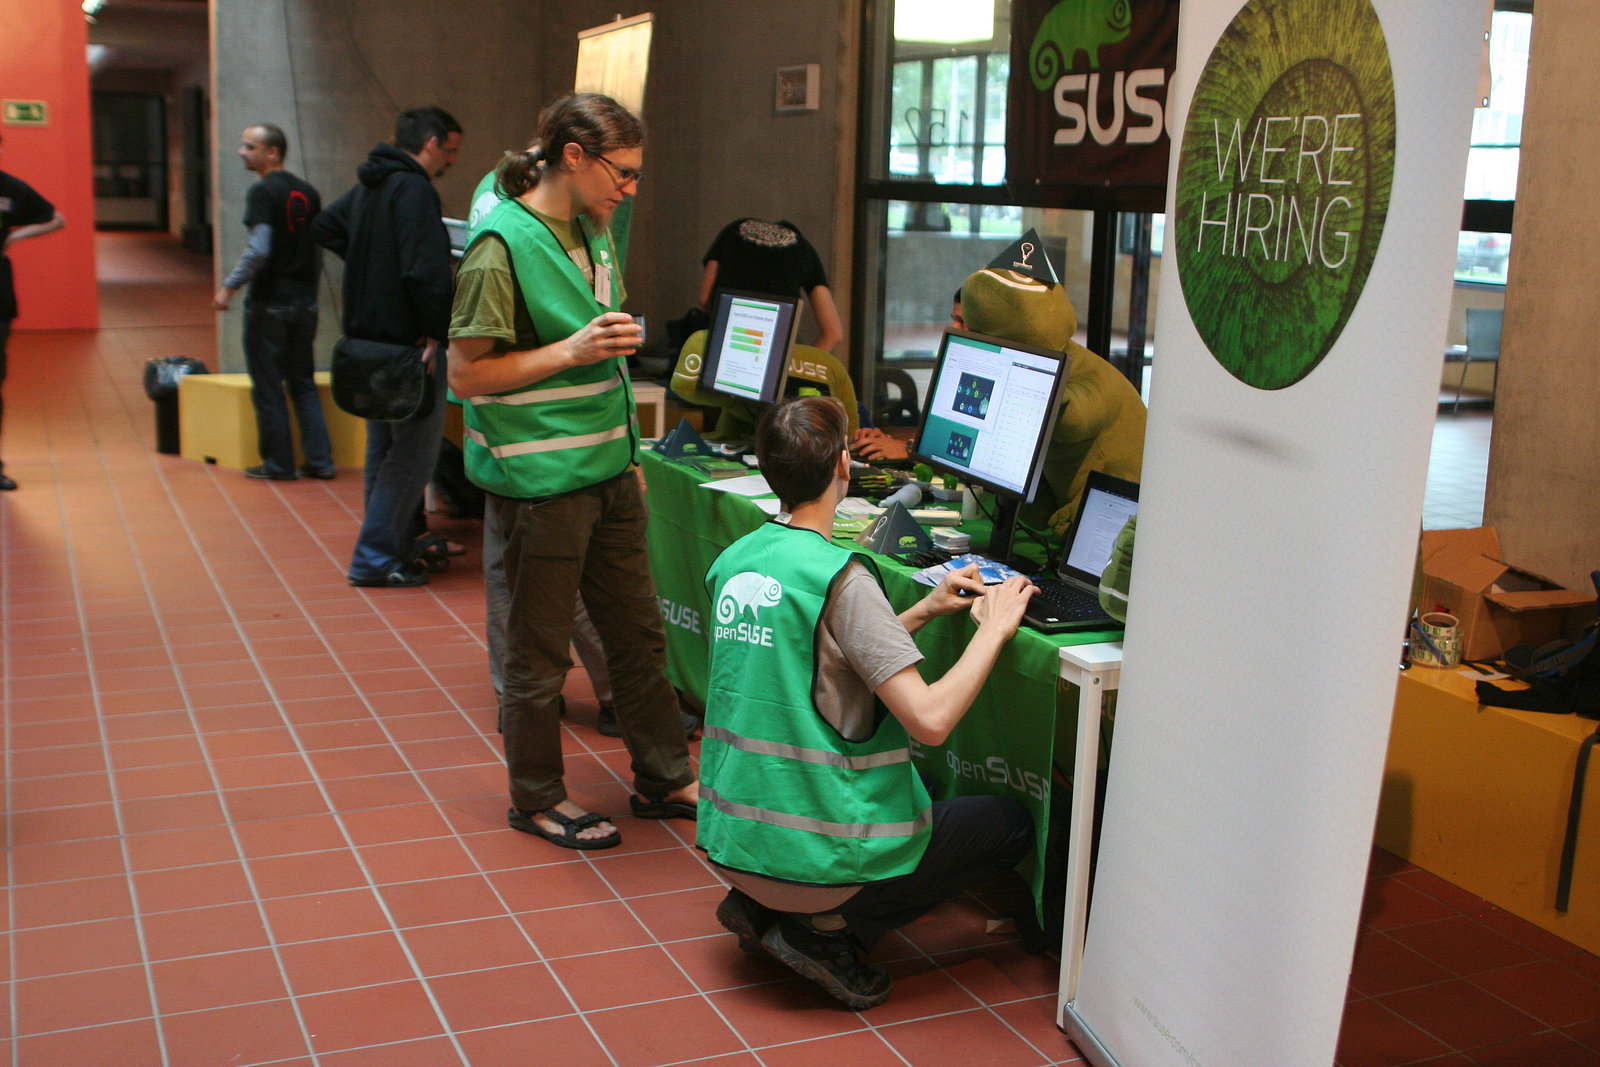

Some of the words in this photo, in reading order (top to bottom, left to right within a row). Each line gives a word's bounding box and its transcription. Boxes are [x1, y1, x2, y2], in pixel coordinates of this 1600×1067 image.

[1214, 113, 1361, 185] WE'RE
[1197, 191, 1352, 269] HIRING
[788, 358, 828, 380] USE
[713, 622, 774, 648] penSUSE
